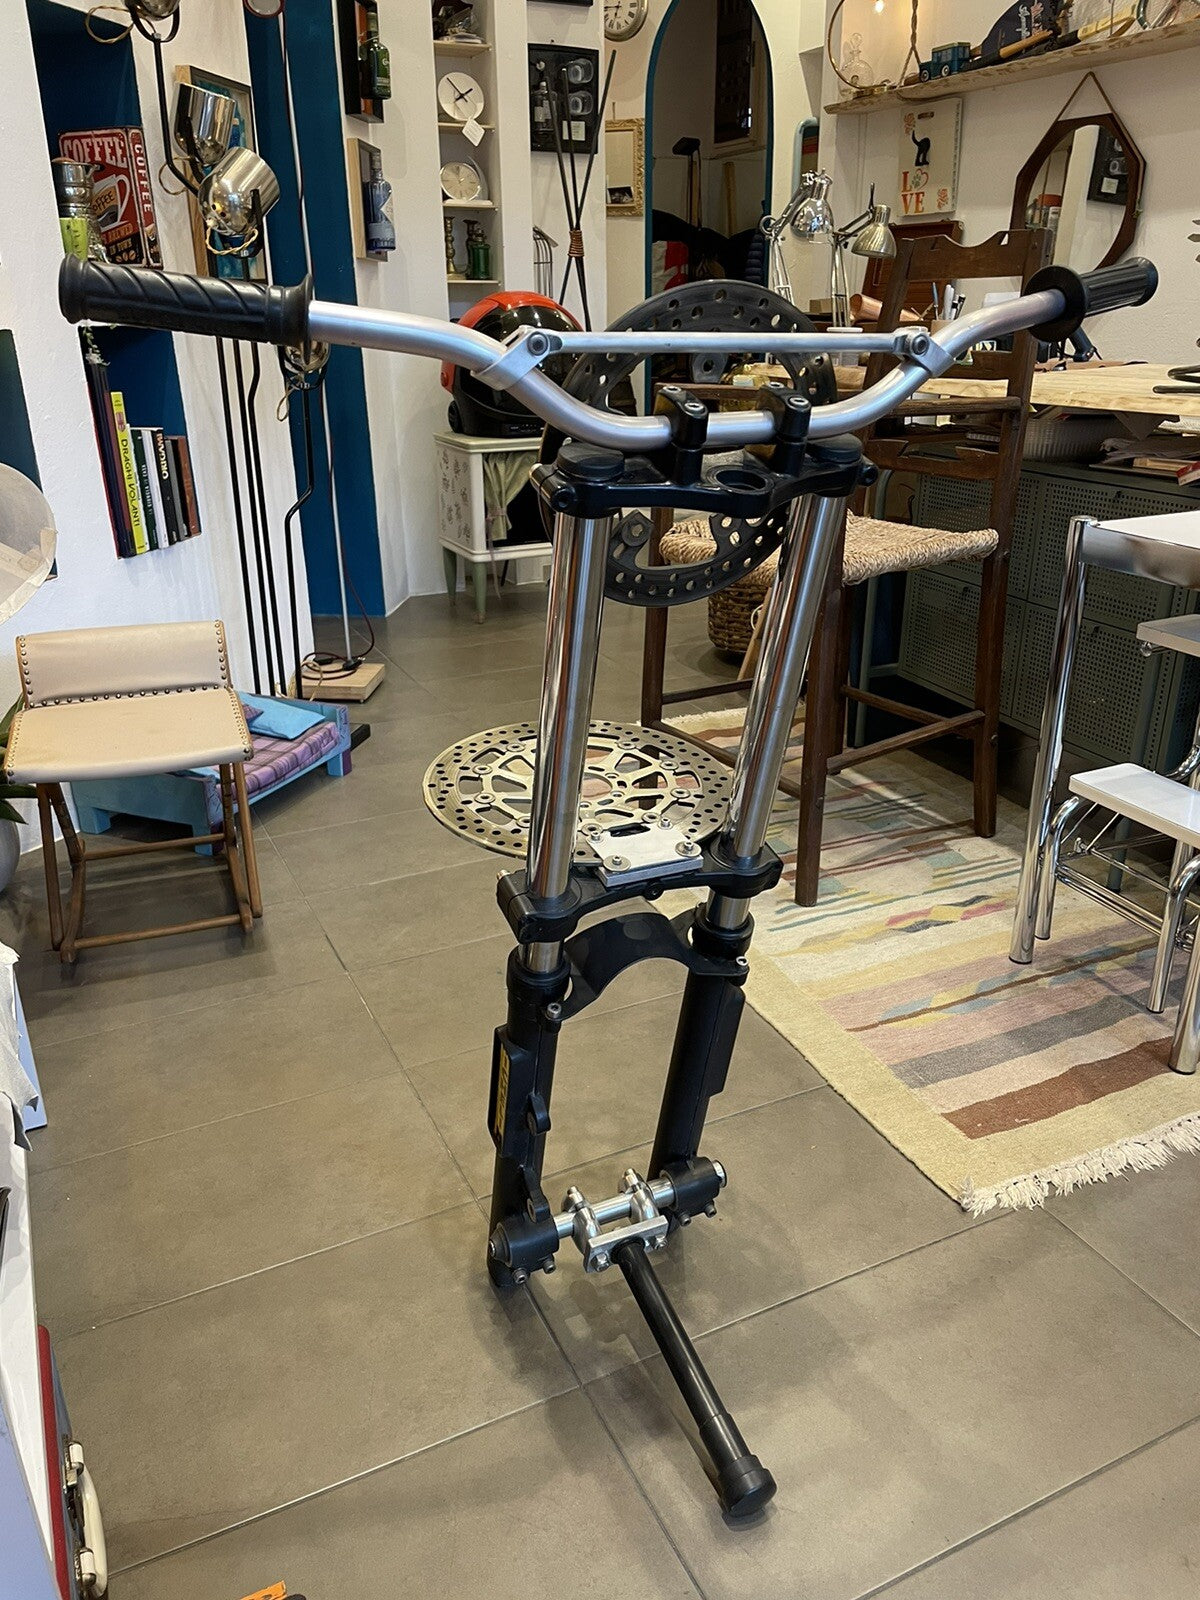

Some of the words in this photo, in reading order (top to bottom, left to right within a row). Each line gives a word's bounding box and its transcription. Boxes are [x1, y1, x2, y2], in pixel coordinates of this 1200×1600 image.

[63, 136, 128, 168] COFFEE
[92, 190, 115, 212] OFFEE
[134, 143, 152, 212] COFFEE
[156, 433, 169, 480] ORIGAMI
[121, 438, 133, 480] DRAGHI
[128, 483, 141, 527] VOLANTI
